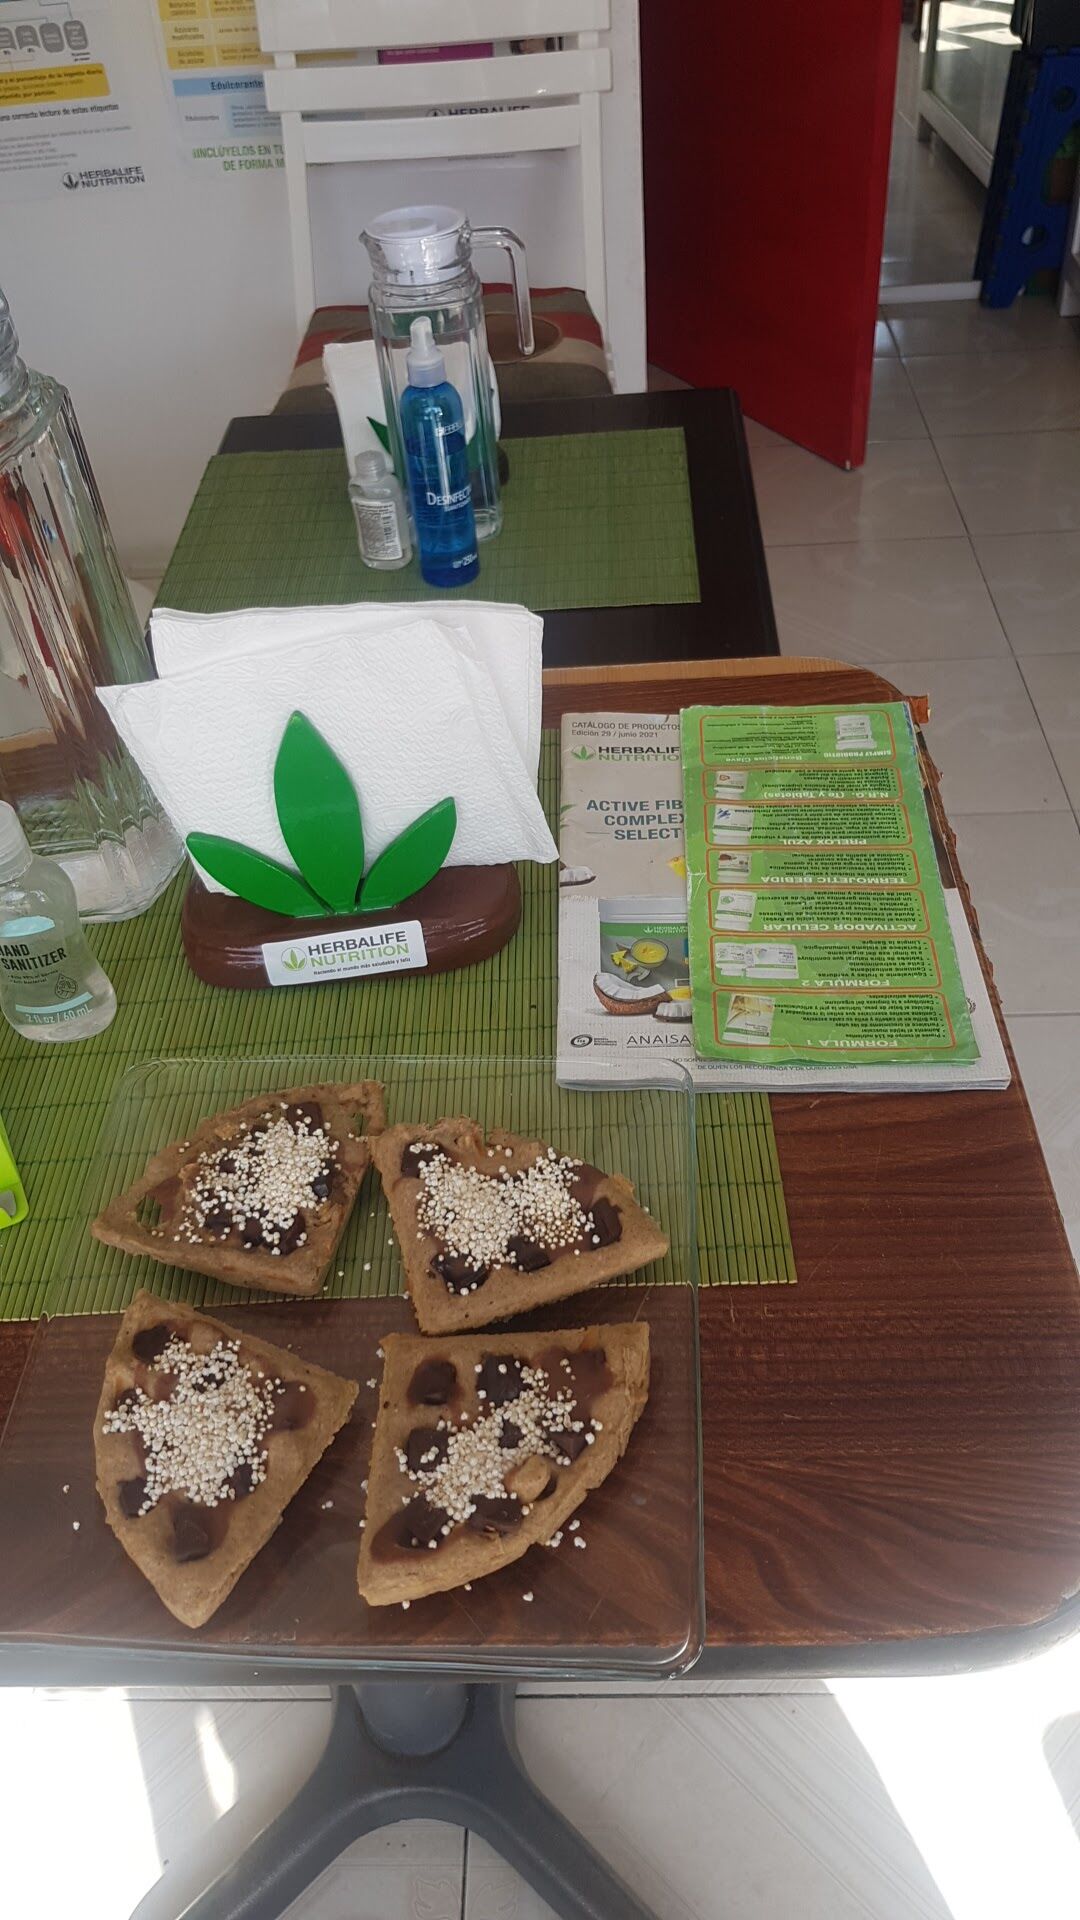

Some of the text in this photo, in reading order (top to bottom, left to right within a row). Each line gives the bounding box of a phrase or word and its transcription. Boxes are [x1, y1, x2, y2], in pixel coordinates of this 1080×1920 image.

[79, 166, 143, 180] HERBALIFE
[81, 175, 145, 189] NUTRITION
[572, 721, 615, 729] CATÁLOGO
[618, 722, 629, 730] DE
[598, 746, 680, 754] HERBALIF
[586, 800, 683, 811] ACTIVE FIB
[614, 828, 682, 840] SELECT
[308, 930, 407, 956] HERBALIFE
[1, 947, 67, 971] SANITIZER
[310, 943, 409, 968] NUTRITION
[25, 1014, 33, 1022] 2
[63, 1010, 75, 1021] 60
[626, 1034, 692, 1045] ANAISA
